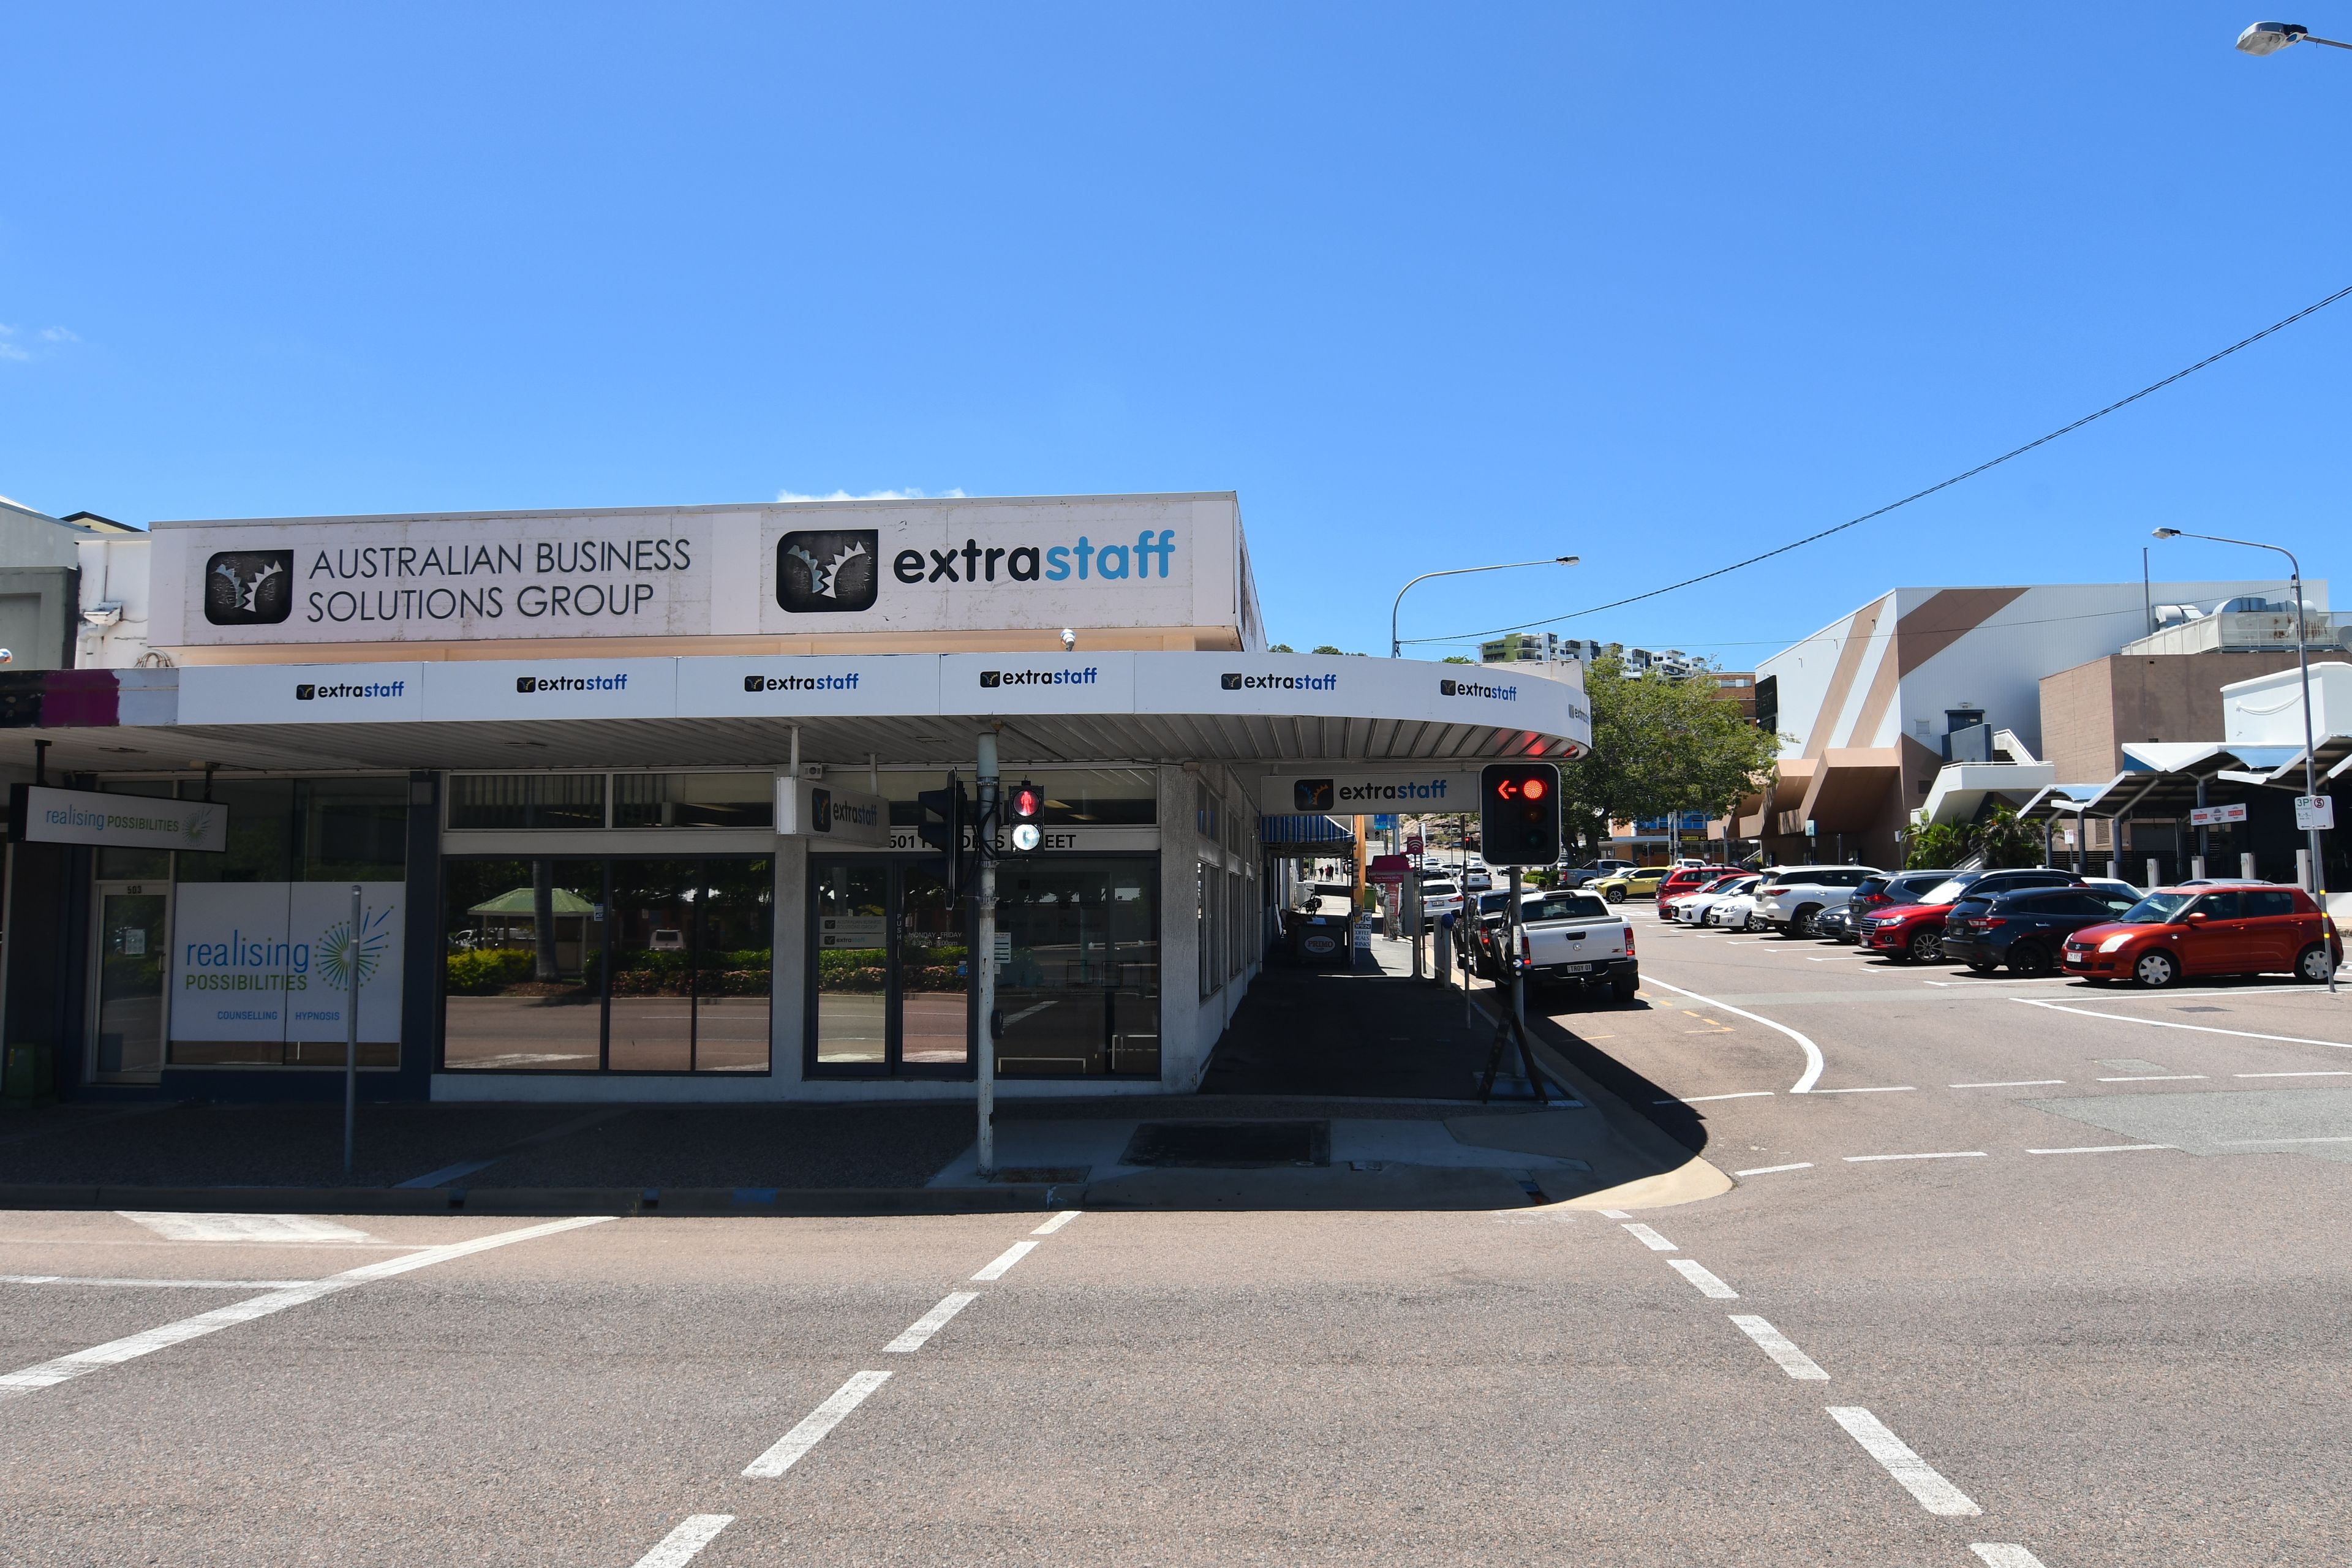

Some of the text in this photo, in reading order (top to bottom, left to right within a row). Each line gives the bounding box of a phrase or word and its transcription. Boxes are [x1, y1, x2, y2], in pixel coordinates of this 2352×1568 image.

[309, 539, 691, 579] AUSTRALIAN BUSINESS
[893, 529, 1176, 584] extrastaff
[307, 584, 654, 622] SOLUTIONS GROUP
[538, 674, 628, 691] extrastaff
[766, 673, 859, 690] extrastaff
[1002, 668, 1098, 685] extrastaff
[1244, 674, 1337, 690] extrastaff
[318, 681, 404, 698] extrastaff
[1458, 682, 1517, 701] extrastaff
[1339, 780, 1447, 801] extrastaff
[2297, 798, 2309, 807] 3P
[46, 804, 179, 832] realising POSSIBILITIES
[833, 800, 878, 826] extrastaff
[889, 835, 914, 849] 501
[127, 885, 142, 895] 503
[186, 930, 309, 973] realising
[186, 974, 307, 990] POSSIBILITIES
[217, 1011, 340, 1020] COUNSELLING HYPNOSIS
